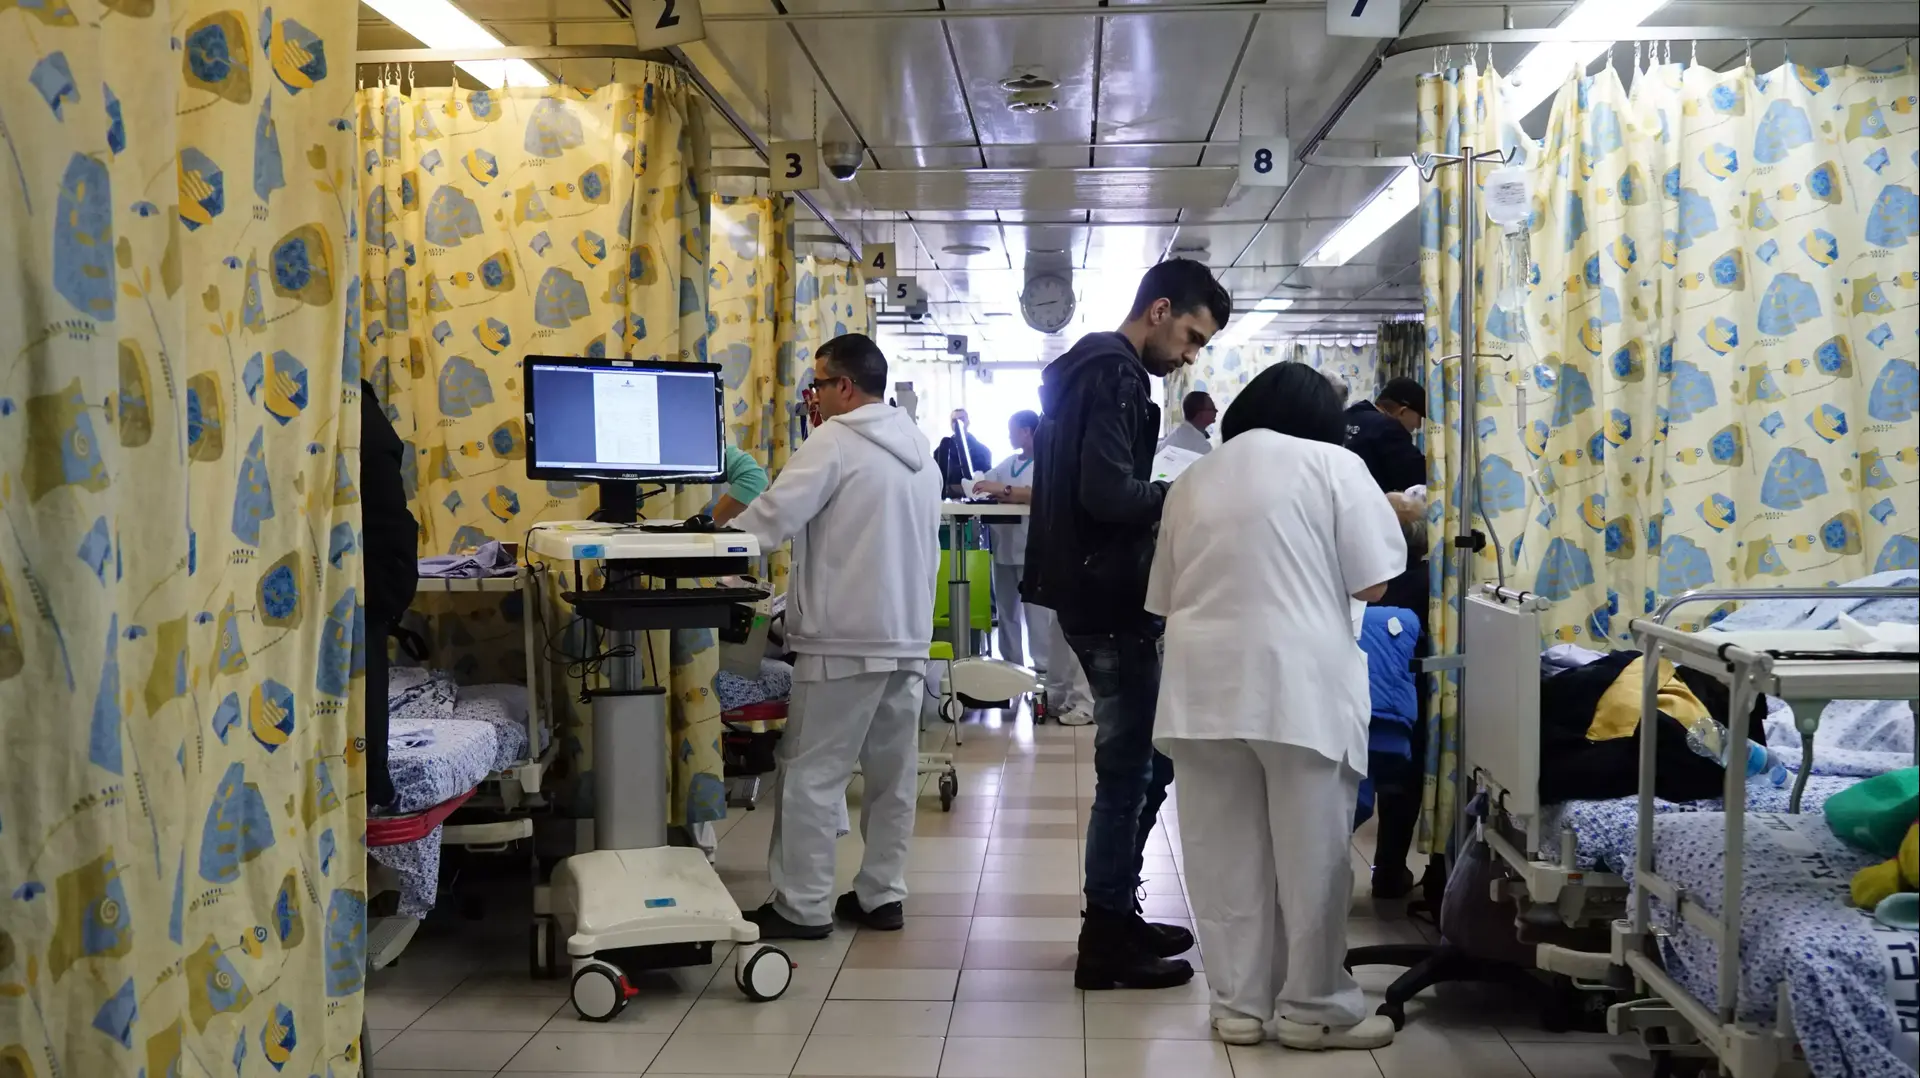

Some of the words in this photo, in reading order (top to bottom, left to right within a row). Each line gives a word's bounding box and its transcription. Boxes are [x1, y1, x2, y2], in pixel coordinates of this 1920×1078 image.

[654, 0, 680, 29] 2
[786, 153, 803, 178] 3
[1253, 148, 1273, 174] 8
[873, 252, 886, 269] 4
[897, 284, 907, 298] 5
[953, 340, 962, 350] 9
[965, 355, 978, 366] 10
